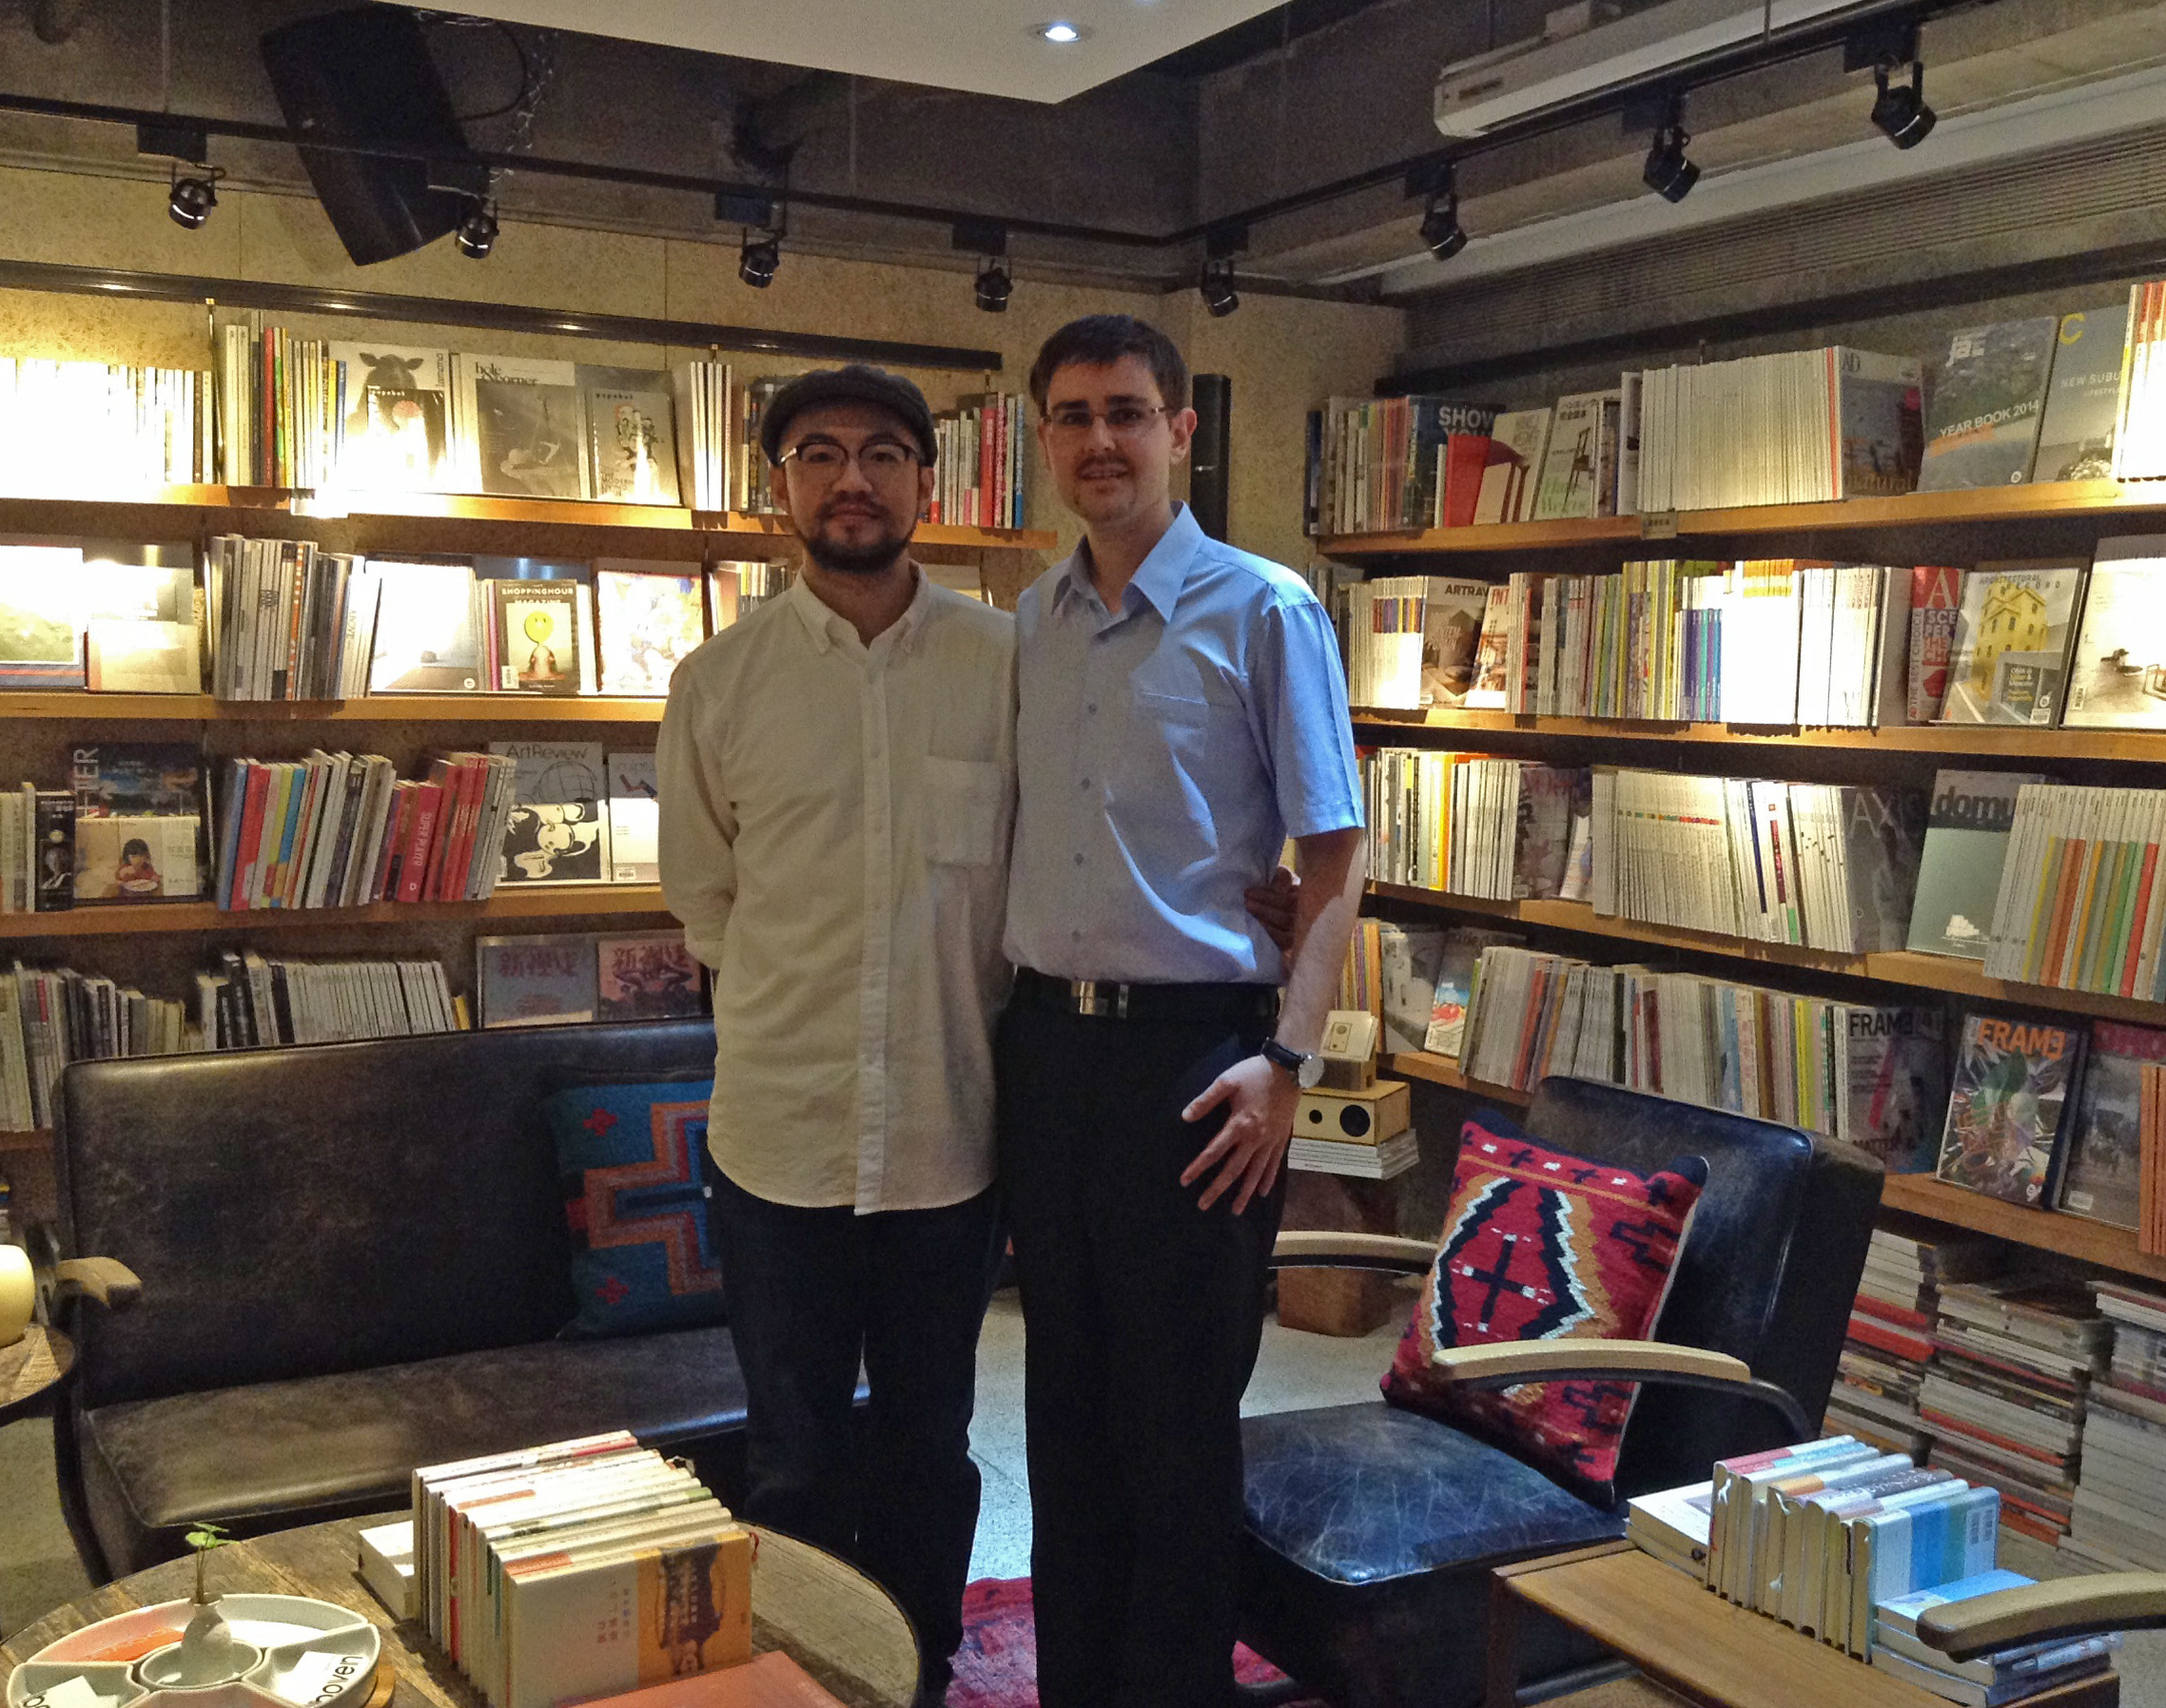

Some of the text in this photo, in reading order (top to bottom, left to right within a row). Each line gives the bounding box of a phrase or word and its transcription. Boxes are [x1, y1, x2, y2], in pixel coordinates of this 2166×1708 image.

[2059, 312, 2086, 345] C
[2060, 374, 2088, 389] NEW
[1438, 405, 1495, 428] SHOW
[1940, 398, 2040, 437] YEAR BOOK 2014
[1925, 568, 1955, 609] A
[506, 744, 589, 761] ArtReview
[412, 811, 433, 867] SUPER PLAYER
[1977, 1018, 2067, 1062] FRAME
